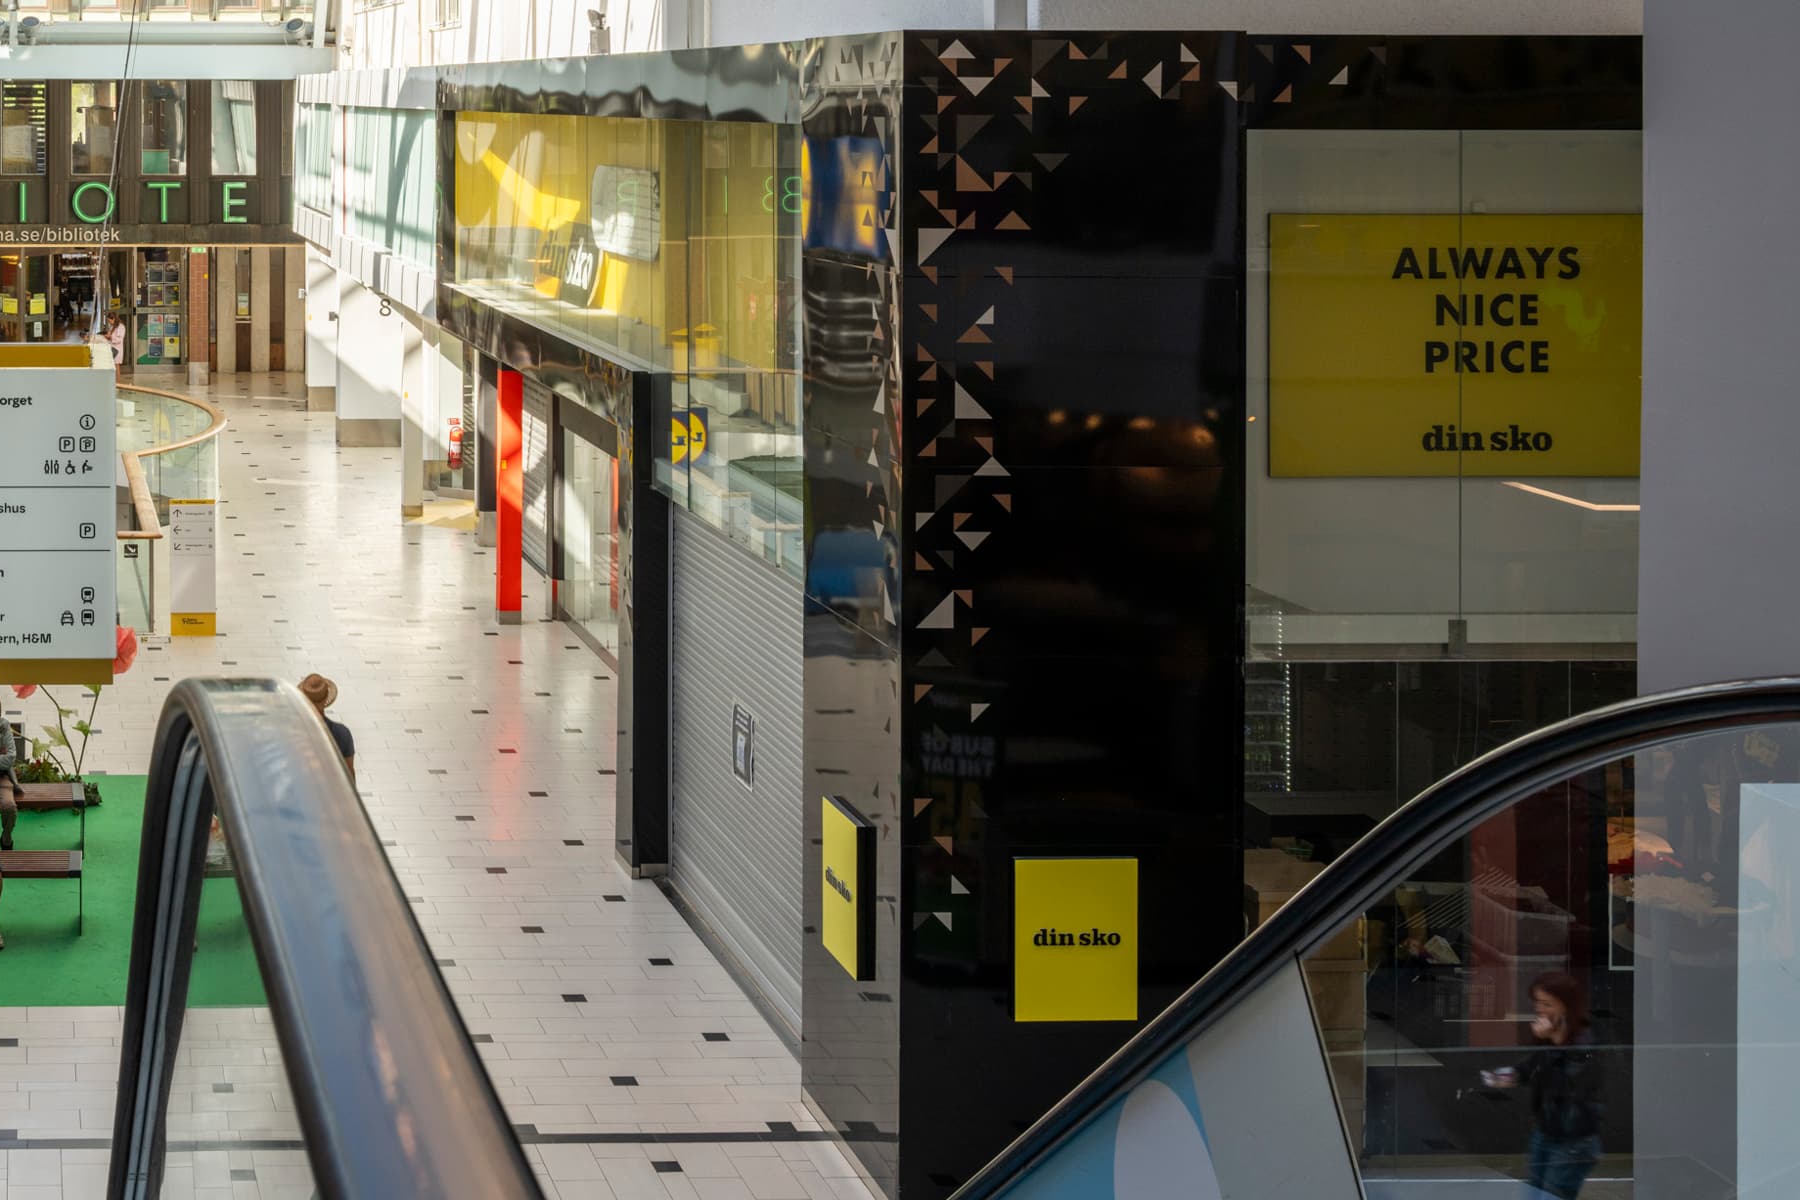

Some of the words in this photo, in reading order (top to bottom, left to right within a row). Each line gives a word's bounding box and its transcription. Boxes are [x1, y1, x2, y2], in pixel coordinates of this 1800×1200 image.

[1391, 246, 1581, 281] ALWAYS
[1435, 293, 1539, 327] NICE
[1425, 340, 1550, 374] PRICE
[22, 633, 52, 644] H&M
